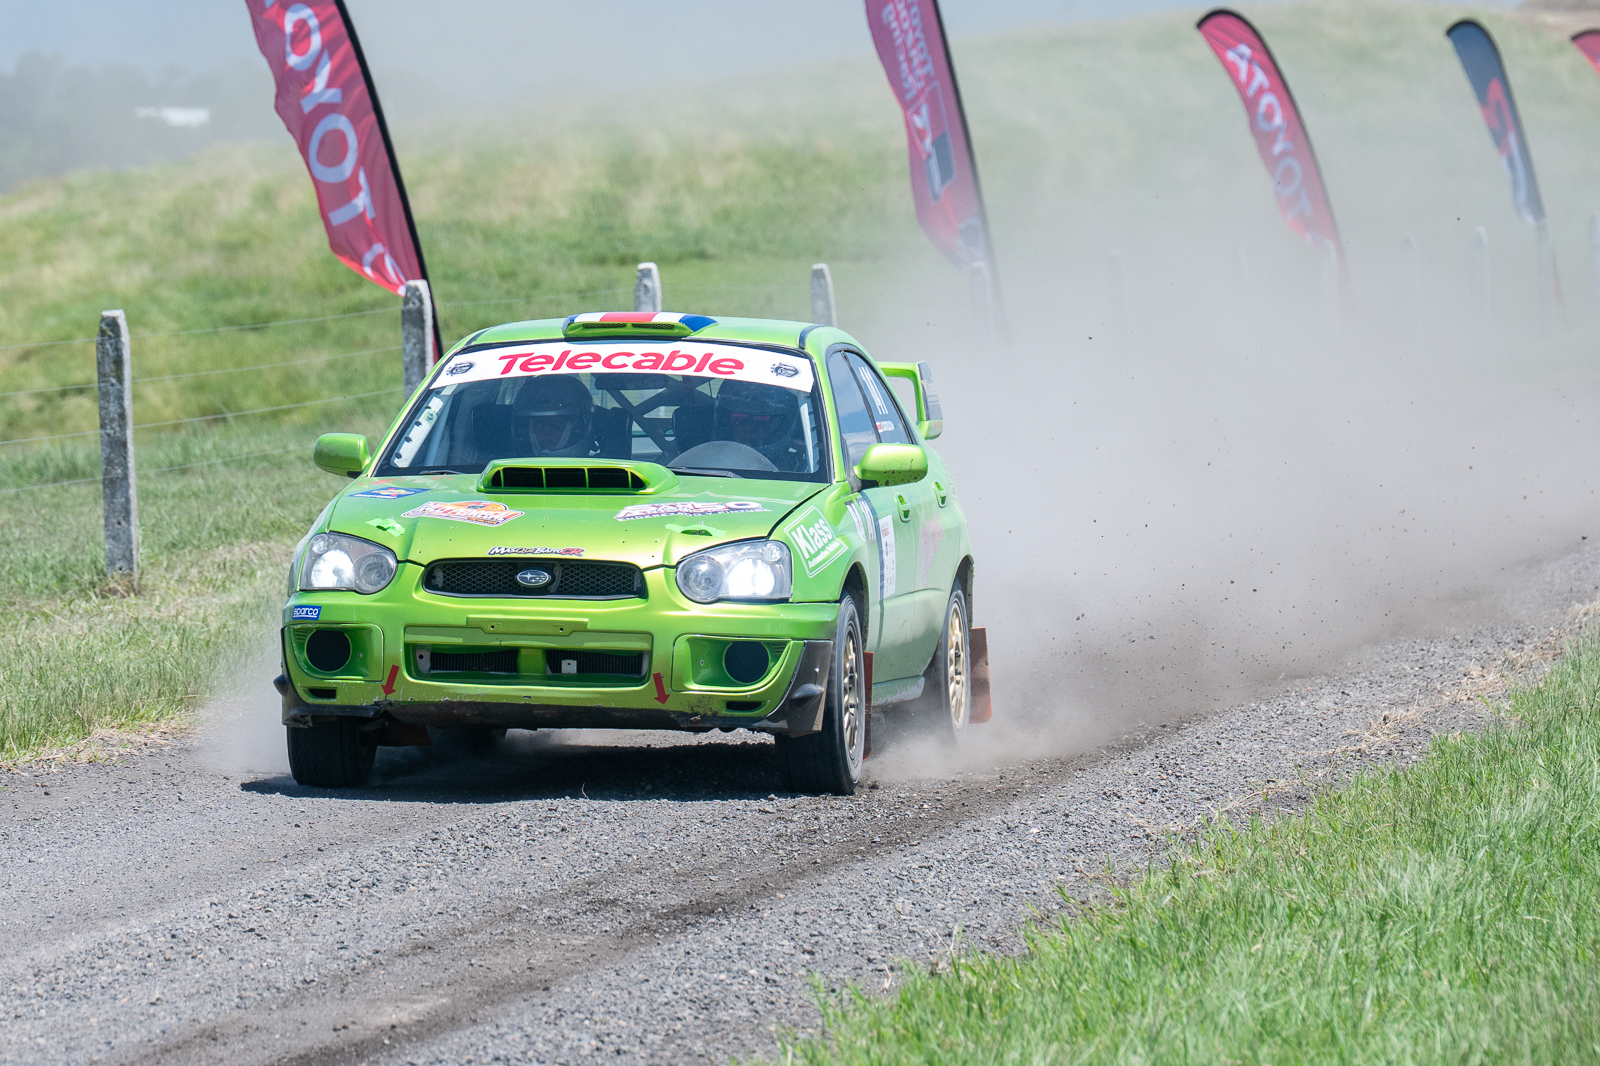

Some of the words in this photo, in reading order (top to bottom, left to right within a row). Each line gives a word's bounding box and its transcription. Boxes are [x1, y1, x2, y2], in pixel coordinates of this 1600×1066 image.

[498, 350, 745, 375] Telecable
[790, 518, 833, 560] Klass
[293, 607, 319, 617] sparco
